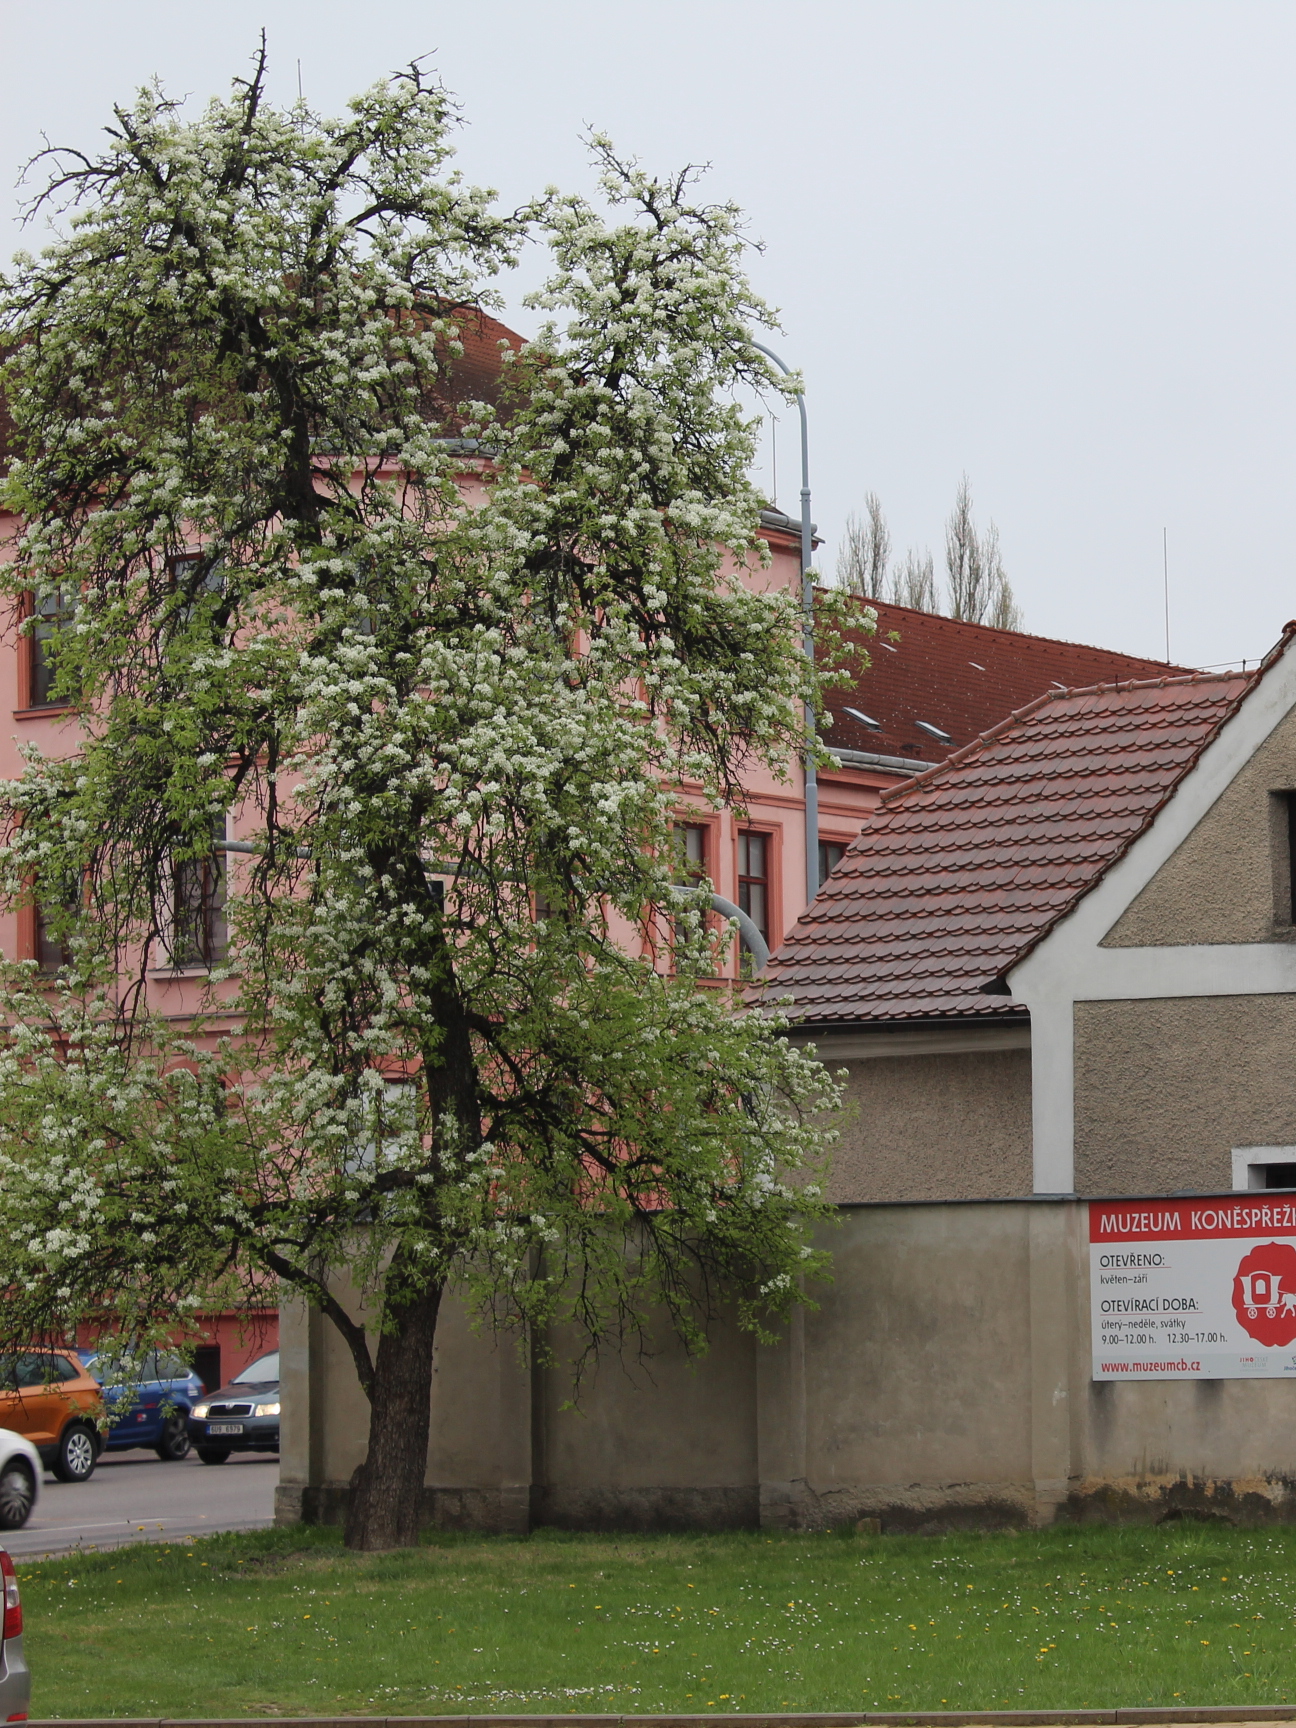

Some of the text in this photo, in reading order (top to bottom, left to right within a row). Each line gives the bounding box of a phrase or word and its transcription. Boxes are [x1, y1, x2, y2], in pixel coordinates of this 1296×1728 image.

[1099, 1211, 1182, 1233] MUZEUM
[1100, 1252, 1165, 1268] OTEVŘENO:
[1100, 1297, 1199, 1313] OTEVÍRACÍ DOBA:
[1160, 1318, 1186, 1330] svátky
[1148, 1333, 1157, 1344] h.
[1219, 1332, 1228, 1343] h.
[1101, 1358, 1201, 1373] www.muzeumcb.cz
